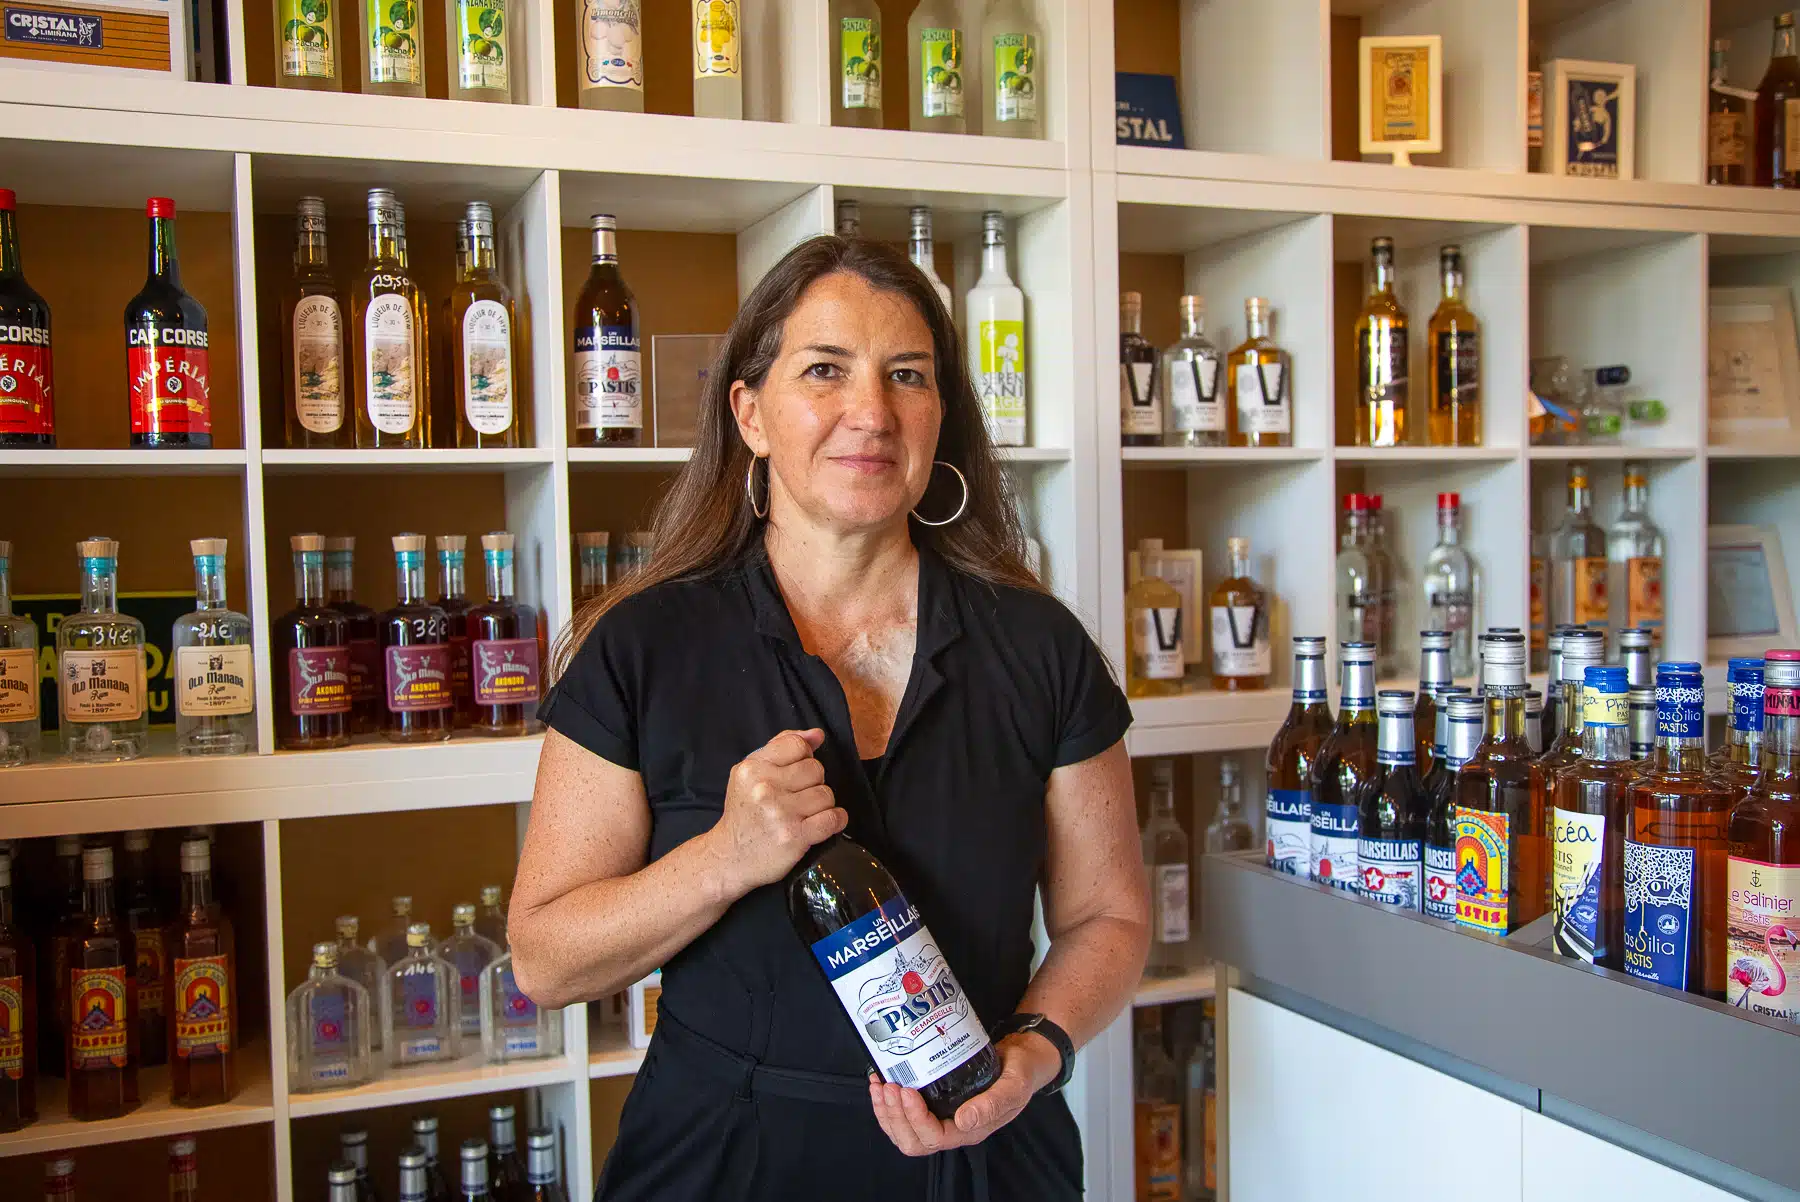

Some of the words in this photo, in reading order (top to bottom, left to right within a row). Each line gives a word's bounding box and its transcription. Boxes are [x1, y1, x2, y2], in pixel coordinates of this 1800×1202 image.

[10, 13, 78, 32] CRISTAL
[40, 29, 78, 39] LIMIÑANA
[298, 304, 318, 330] LIQUEUR
[319, 304, 330, 314] DE
[371, 303, 391, 329] LIQUEUR
[392, 303, 403, 313] DE
[487, 309, 497, 319] DE
[129, 328, 160, 345] CAP
[162, 328, 209, 347] CORSE
[133, 356, 210, 399] IMPÉRIAL
[198, 622, 232, 639] 21€
[71, 681, 86, 695] OLD
[188, 675, 204, 690] OLD
[208, 684, 226, 695] Rum
[90, 690, 109, 700] Rum
[1659, 722, 1689, 733] PASTIS
[1743, 889, 1794, 911] Salinier
[872, 916, 886, 927] UN
[1742, 911, 1771, 926] Pastis
[827, 904, 920, 969] MARSEILLAIS
[1625, 949, 1653, 969] PASTIS
[882, 976, 956, 1034] PASTIS
[1752, 1003, 1788, 1019] CRISTAL
[910, 1026, 921, 1037] DE
[919, 1005, 954, 1030] MARSEILLE
[928, 1048, 948, 1062] CRISTAL
[947, 1032, 971, 1051] LIMIÑANA
